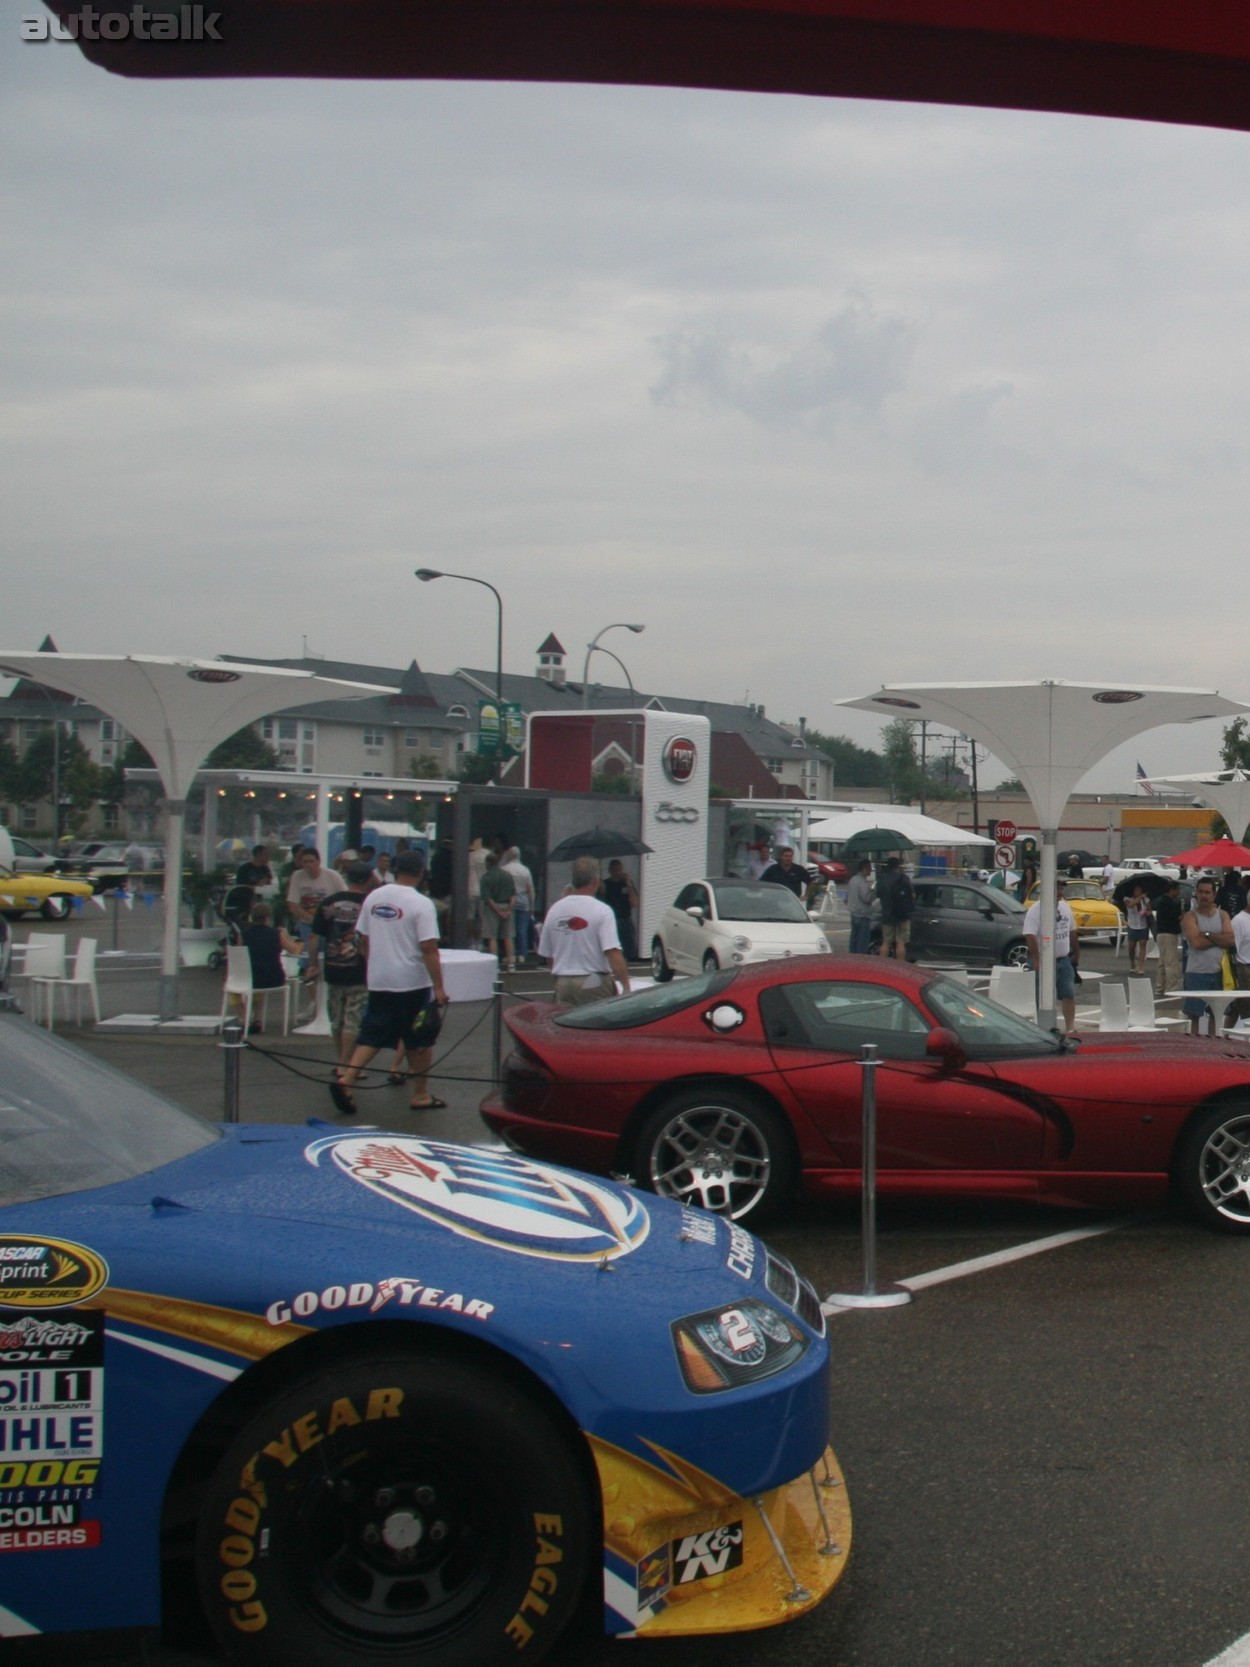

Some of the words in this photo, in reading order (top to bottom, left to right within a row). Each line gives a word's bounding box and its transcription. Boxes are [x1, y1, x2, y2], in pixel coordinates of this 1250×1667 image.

[655, 802, 700, 823] 500
[996, 827, 1015, 837] STOP
[0, 1262, 49, 1283] print
[28, 1290, 83, 1298] SERIES
[24, 1330, 95, 1346] LIGHT
[719, 1309, 756, 1351] 2
[0, 1350, 74, 1361] OLE
[39, 1487, 93, 1501] PARTS
[504, 1512, 563, 1649] EAGLE
